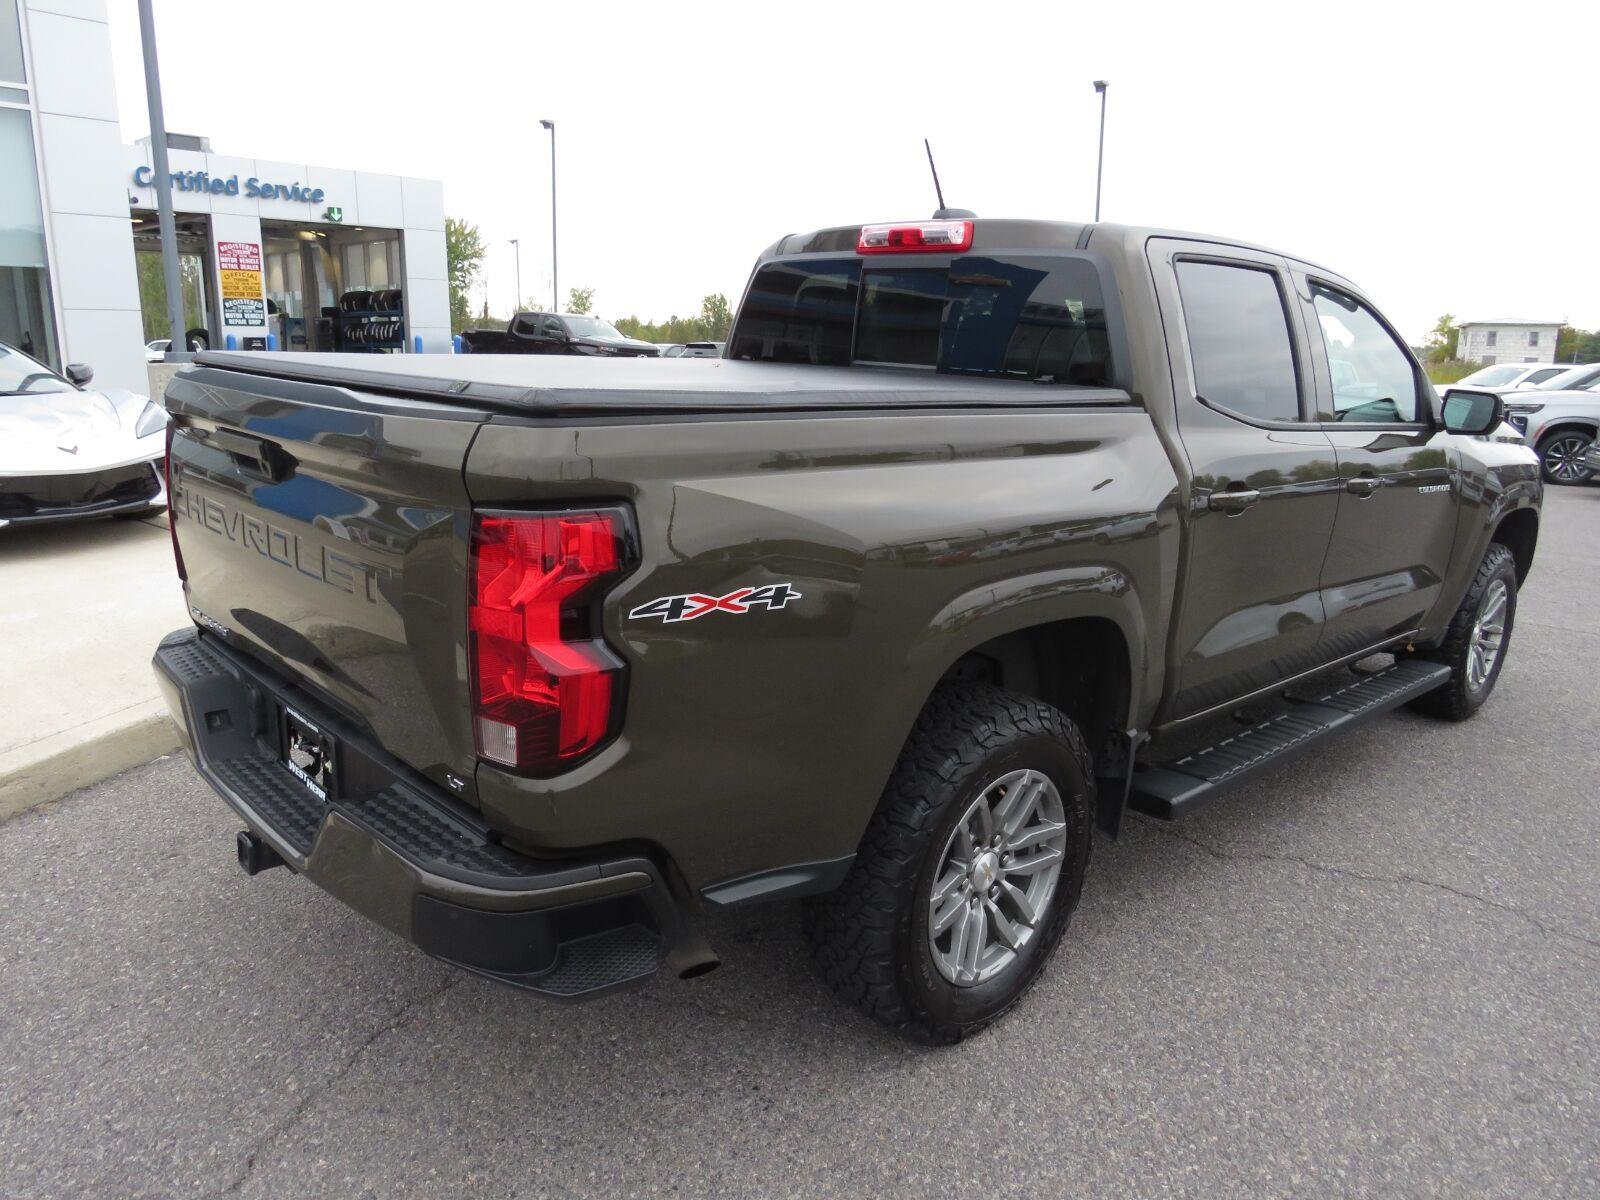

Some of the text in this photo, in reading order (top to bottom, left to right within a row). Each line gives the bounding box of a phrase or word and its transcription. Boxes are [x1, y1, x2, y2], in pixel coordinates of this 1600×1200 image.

[133, 166, 325, 204] Crtified Service
[220, 243, 258, 253] REGISTERED
[224, 271, 258, 282] OFFICIAL
[225, 299, 263, 309] REGISTERED
[174, 482, 394, 605] CHEVROLET
[288, 759, 326, 801] WEST HERR
